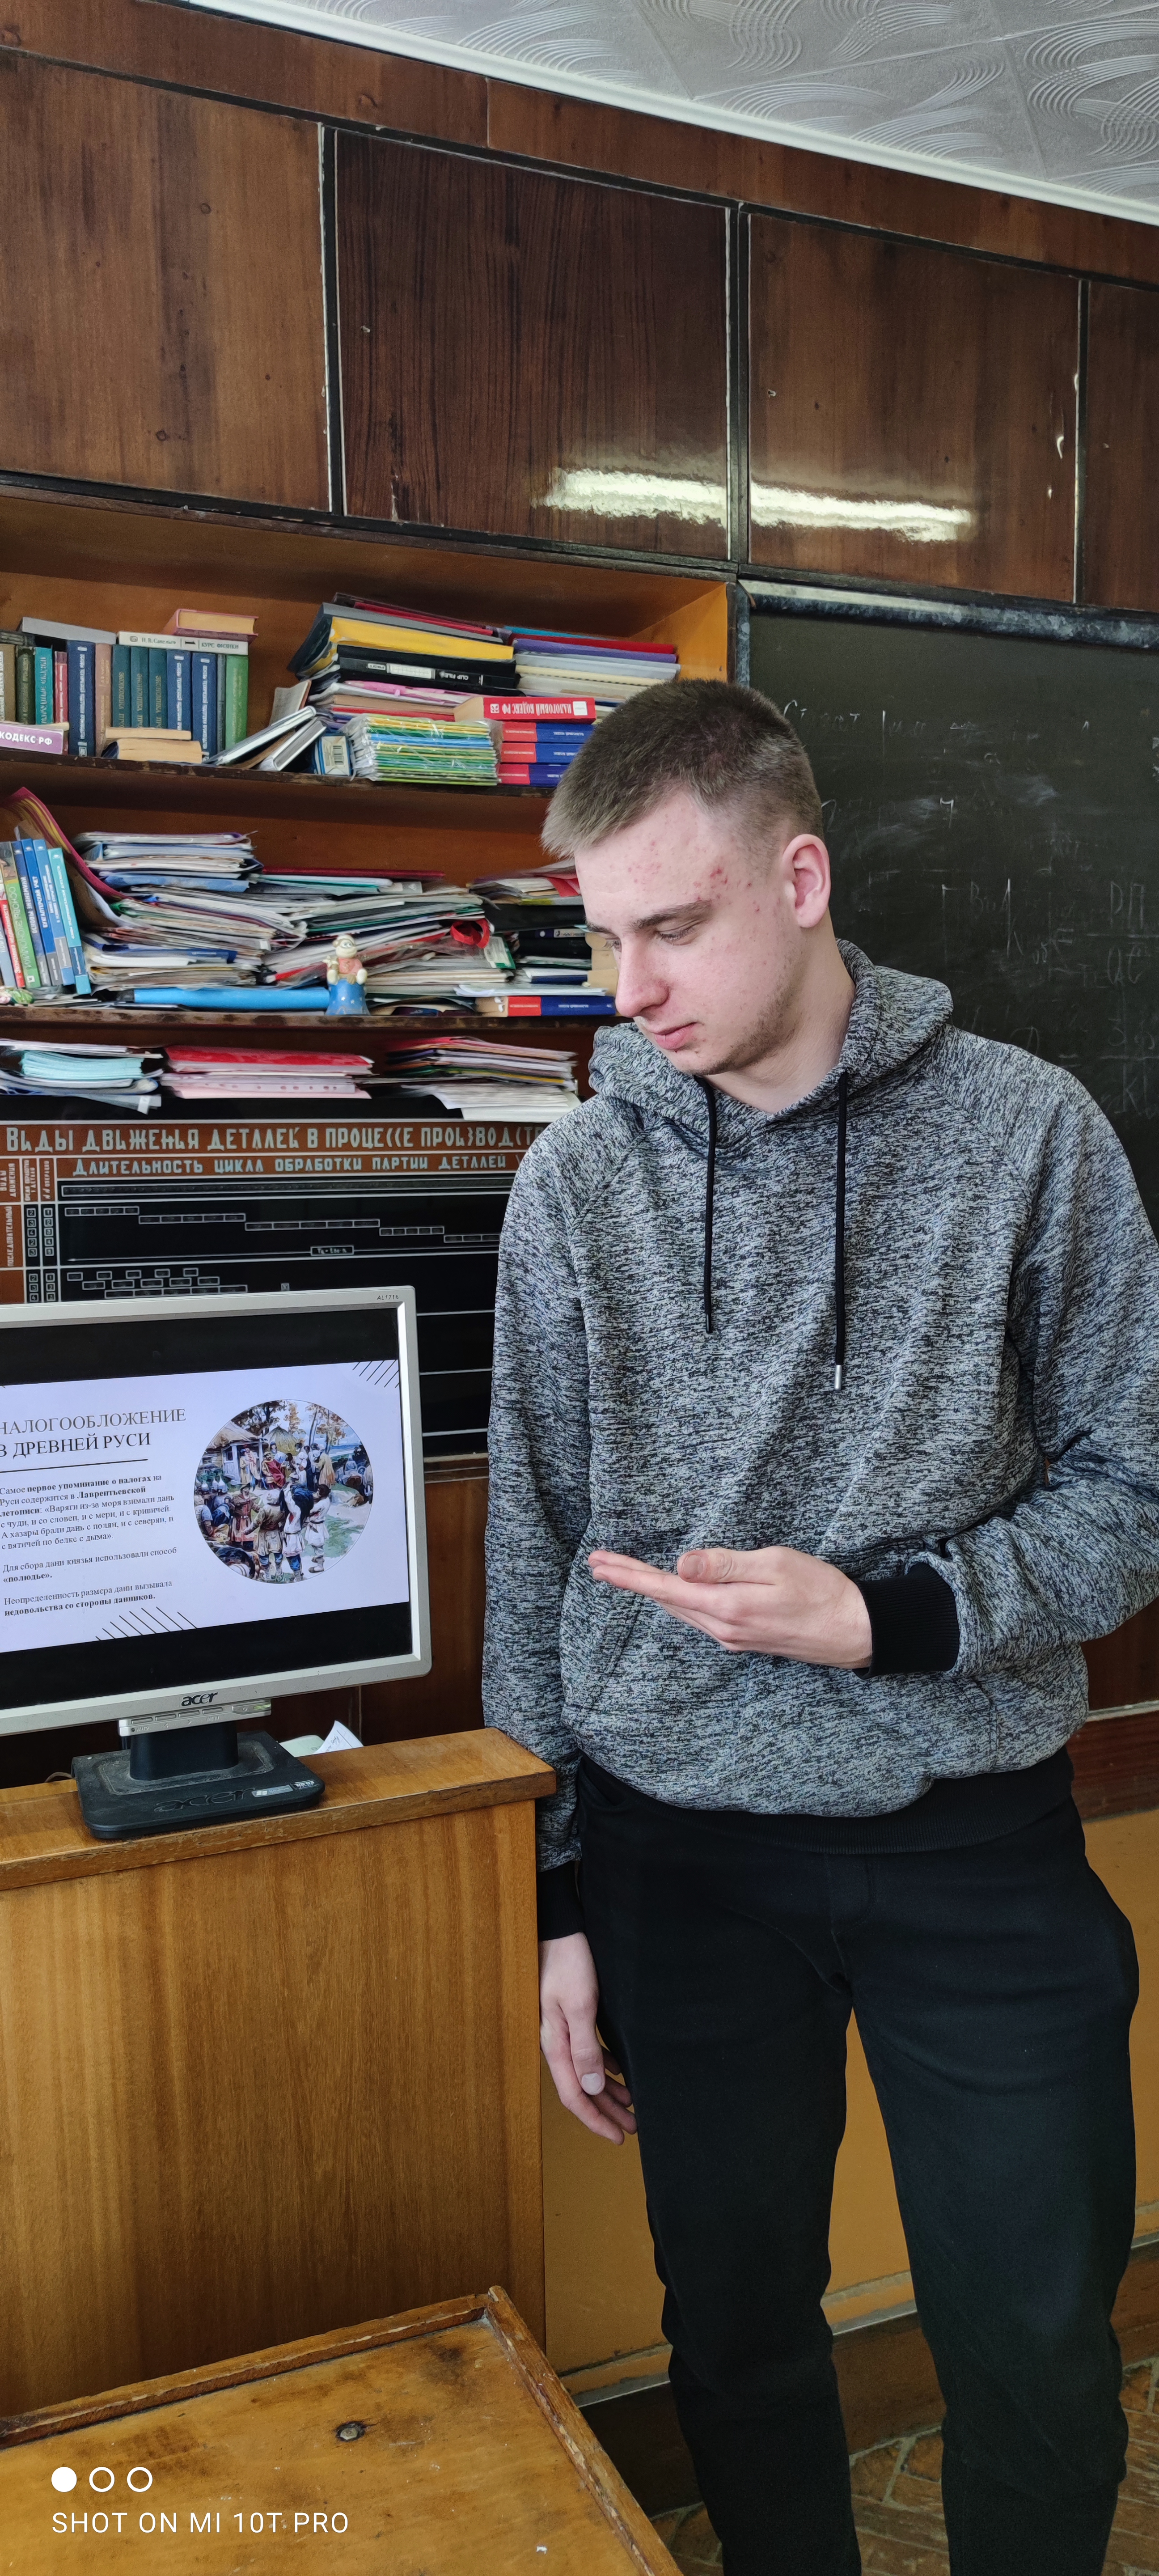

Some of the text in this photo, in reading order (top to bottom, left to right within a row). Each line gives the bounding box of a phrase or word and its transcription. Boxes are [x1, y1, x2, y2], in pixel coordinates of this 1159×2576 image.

[501, 702, 572, 717] НАЛОГОВЫЙ КОДЕКС РФ
[0, 731, 53, 746] КОДЕКС РФ
[21, 876, 38, 934] ОСНОВЫ ЭКОНОМИКИ
[34, 889, 48, 928] БУХГАЛТЕРСКИЙ
[307, 1127, 318, 1148] В
[73, 1158, 203, 1177] ДЛИТЕЛЬНОСТЬ
[215, 1159, 264, 1175] ЦИКЛА
[275, 1157, 362, 1172] ОБРАБОТКИ
[372, 1156, 428, 1170] ПАРТИИ
[438, 1155, 506, 1169] ДЕТАЛЕЙ
[0, 1408, 186, 1435] НАЛОГООБЛОЖЕНИЕ
[0, 1432, 151, 1459] В ДРЕВНЕЙ РУСИ
[27, 1484, 56, 1493] первое
[58, 1480, 110, 1491] упоминание
[118, 1476, 151, 1484] налогах
[0, 1498, 20, 1507] Руси
[21, 1494, 68, 1504] содержится
[76, 1485, 146, 1499] Лаврентьевской
[0, 1508, 42, 1517] летописи:
[45, 1504, 78, 1513] «Варяги
[102, 1500, 121, 1508] моря
[123, 1497, 155, 1505] взимали
[7, 1520, 29, 1529] чуди,
[95, 1511, 117, 1520] мери,
[133, 1505, 171, 1517] кривичей.
[10, 1530, 39, 1538] хазары
[40, 1527, 64, 1536] брали
[66, 1525, 85, 1533] дань
[134, 1517, 167, 1525] северян,
[8, 1539, 41, 1549] вятичей
[85, 1534, 114, 1542] дыма».
[2, 1546, 177, 1573] Для сбора дани князья использовали способ
[3, 1573, 52, 1582] «полюдье».
[4, 1580, 172, 1605] Неопределенность размера дани вызывала
[4, 1604, 63, 1616] недовольства
[76, 1598, 112, 1608] стороны
[114, 1594, 156, 1604] данников.
[181, 1692, 218, 1707] acer
[154, 1787, 255, 1812] acer
